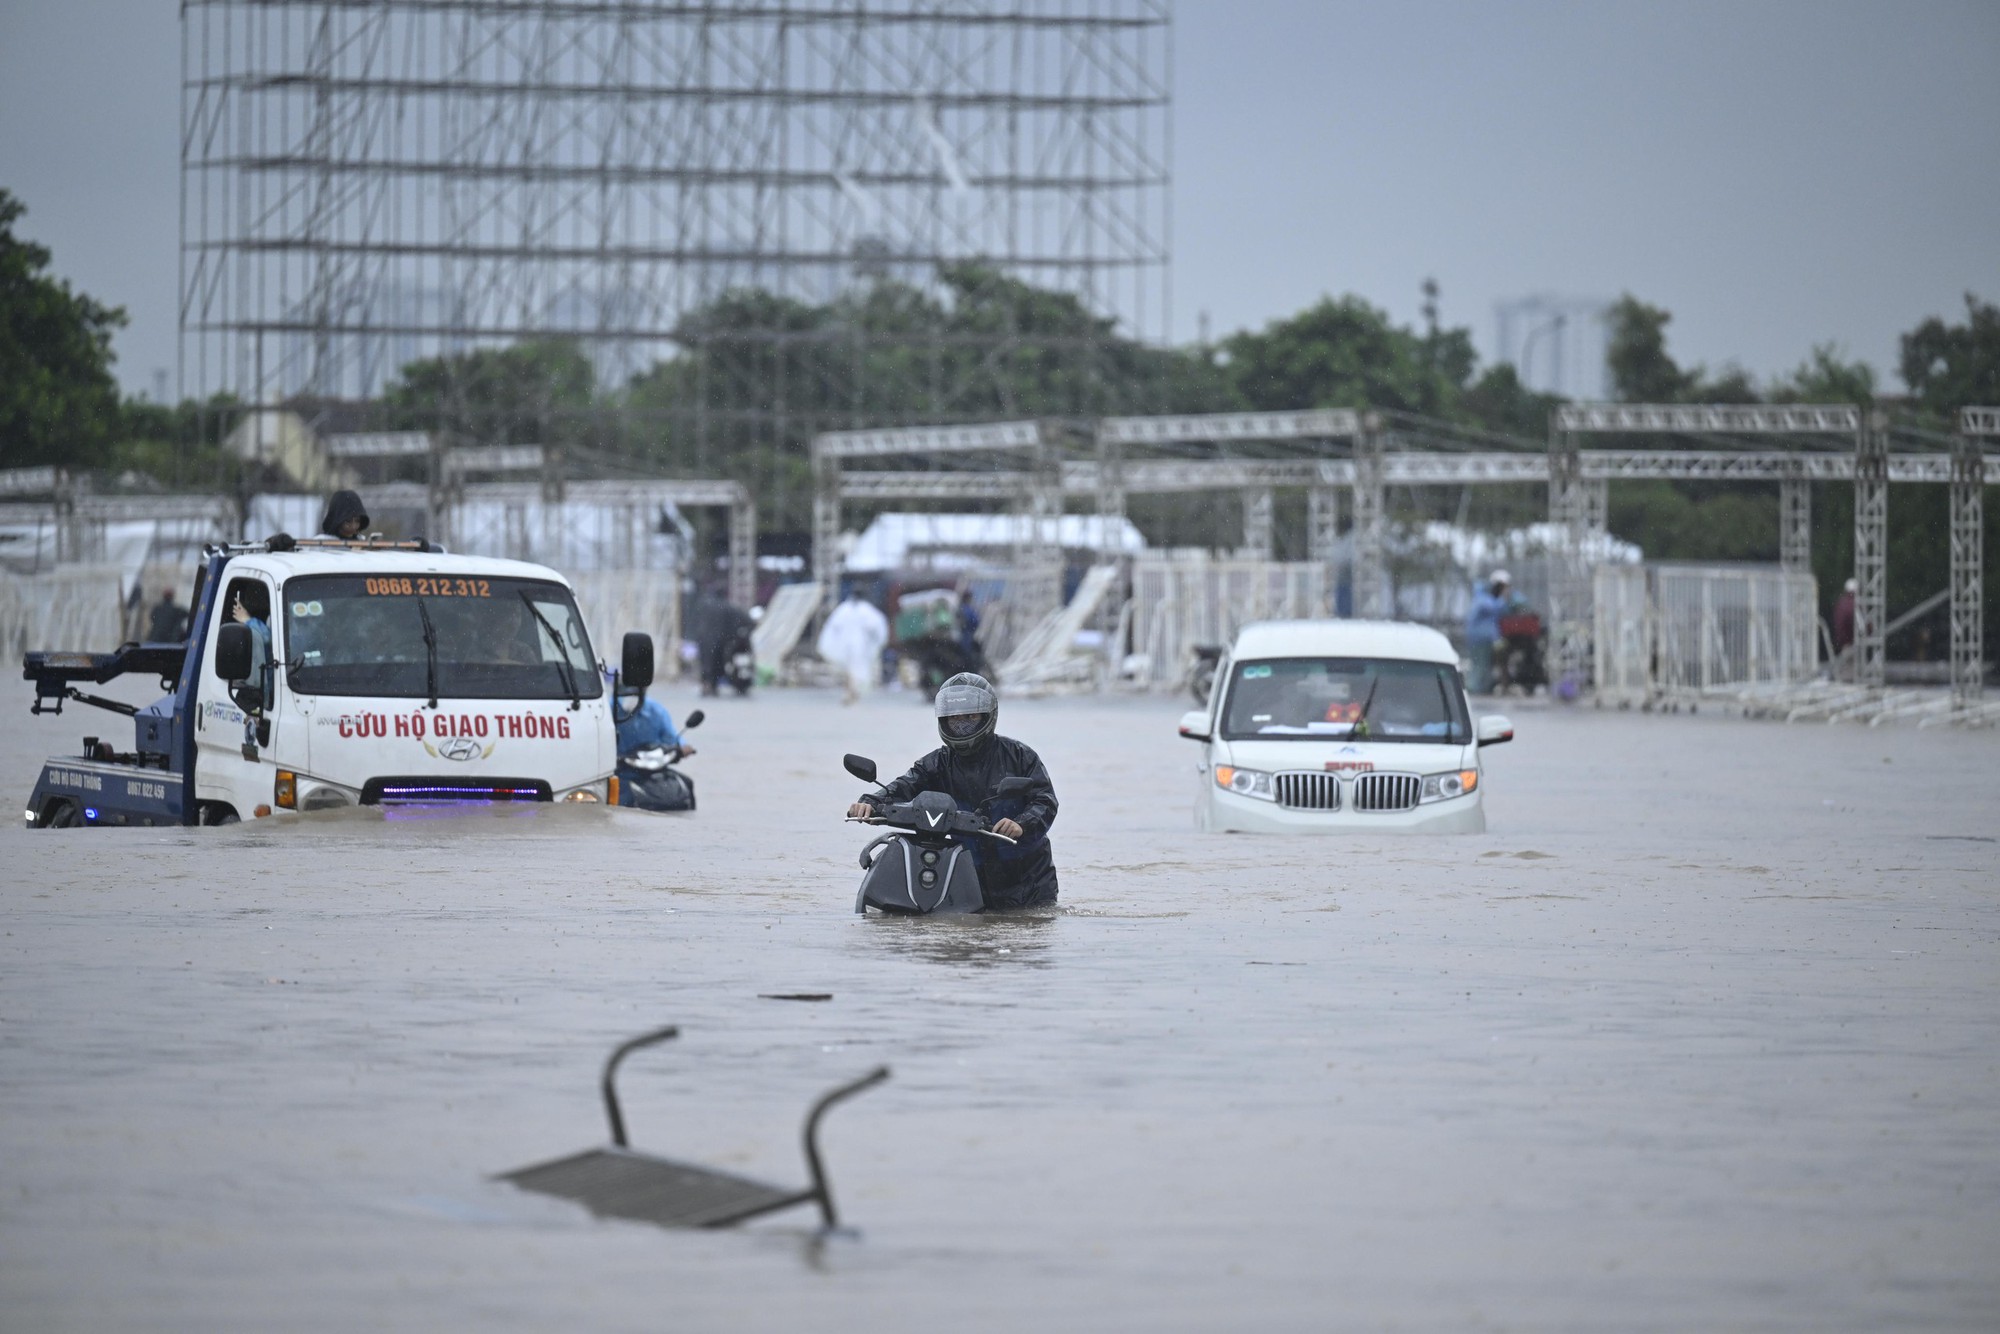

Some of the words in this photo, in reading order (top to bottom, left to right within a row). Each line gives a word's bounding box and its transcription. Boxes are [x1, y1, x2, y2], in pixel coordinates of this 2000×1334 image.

[365, 577, 491, 597] 0868.212.312
[339, 709, 387, 738] CỨU
[394, 709, 426, 741] HỘ
[433, 714, 489, 738] GIAO
[494, 710, 570, 739] THÔNG
